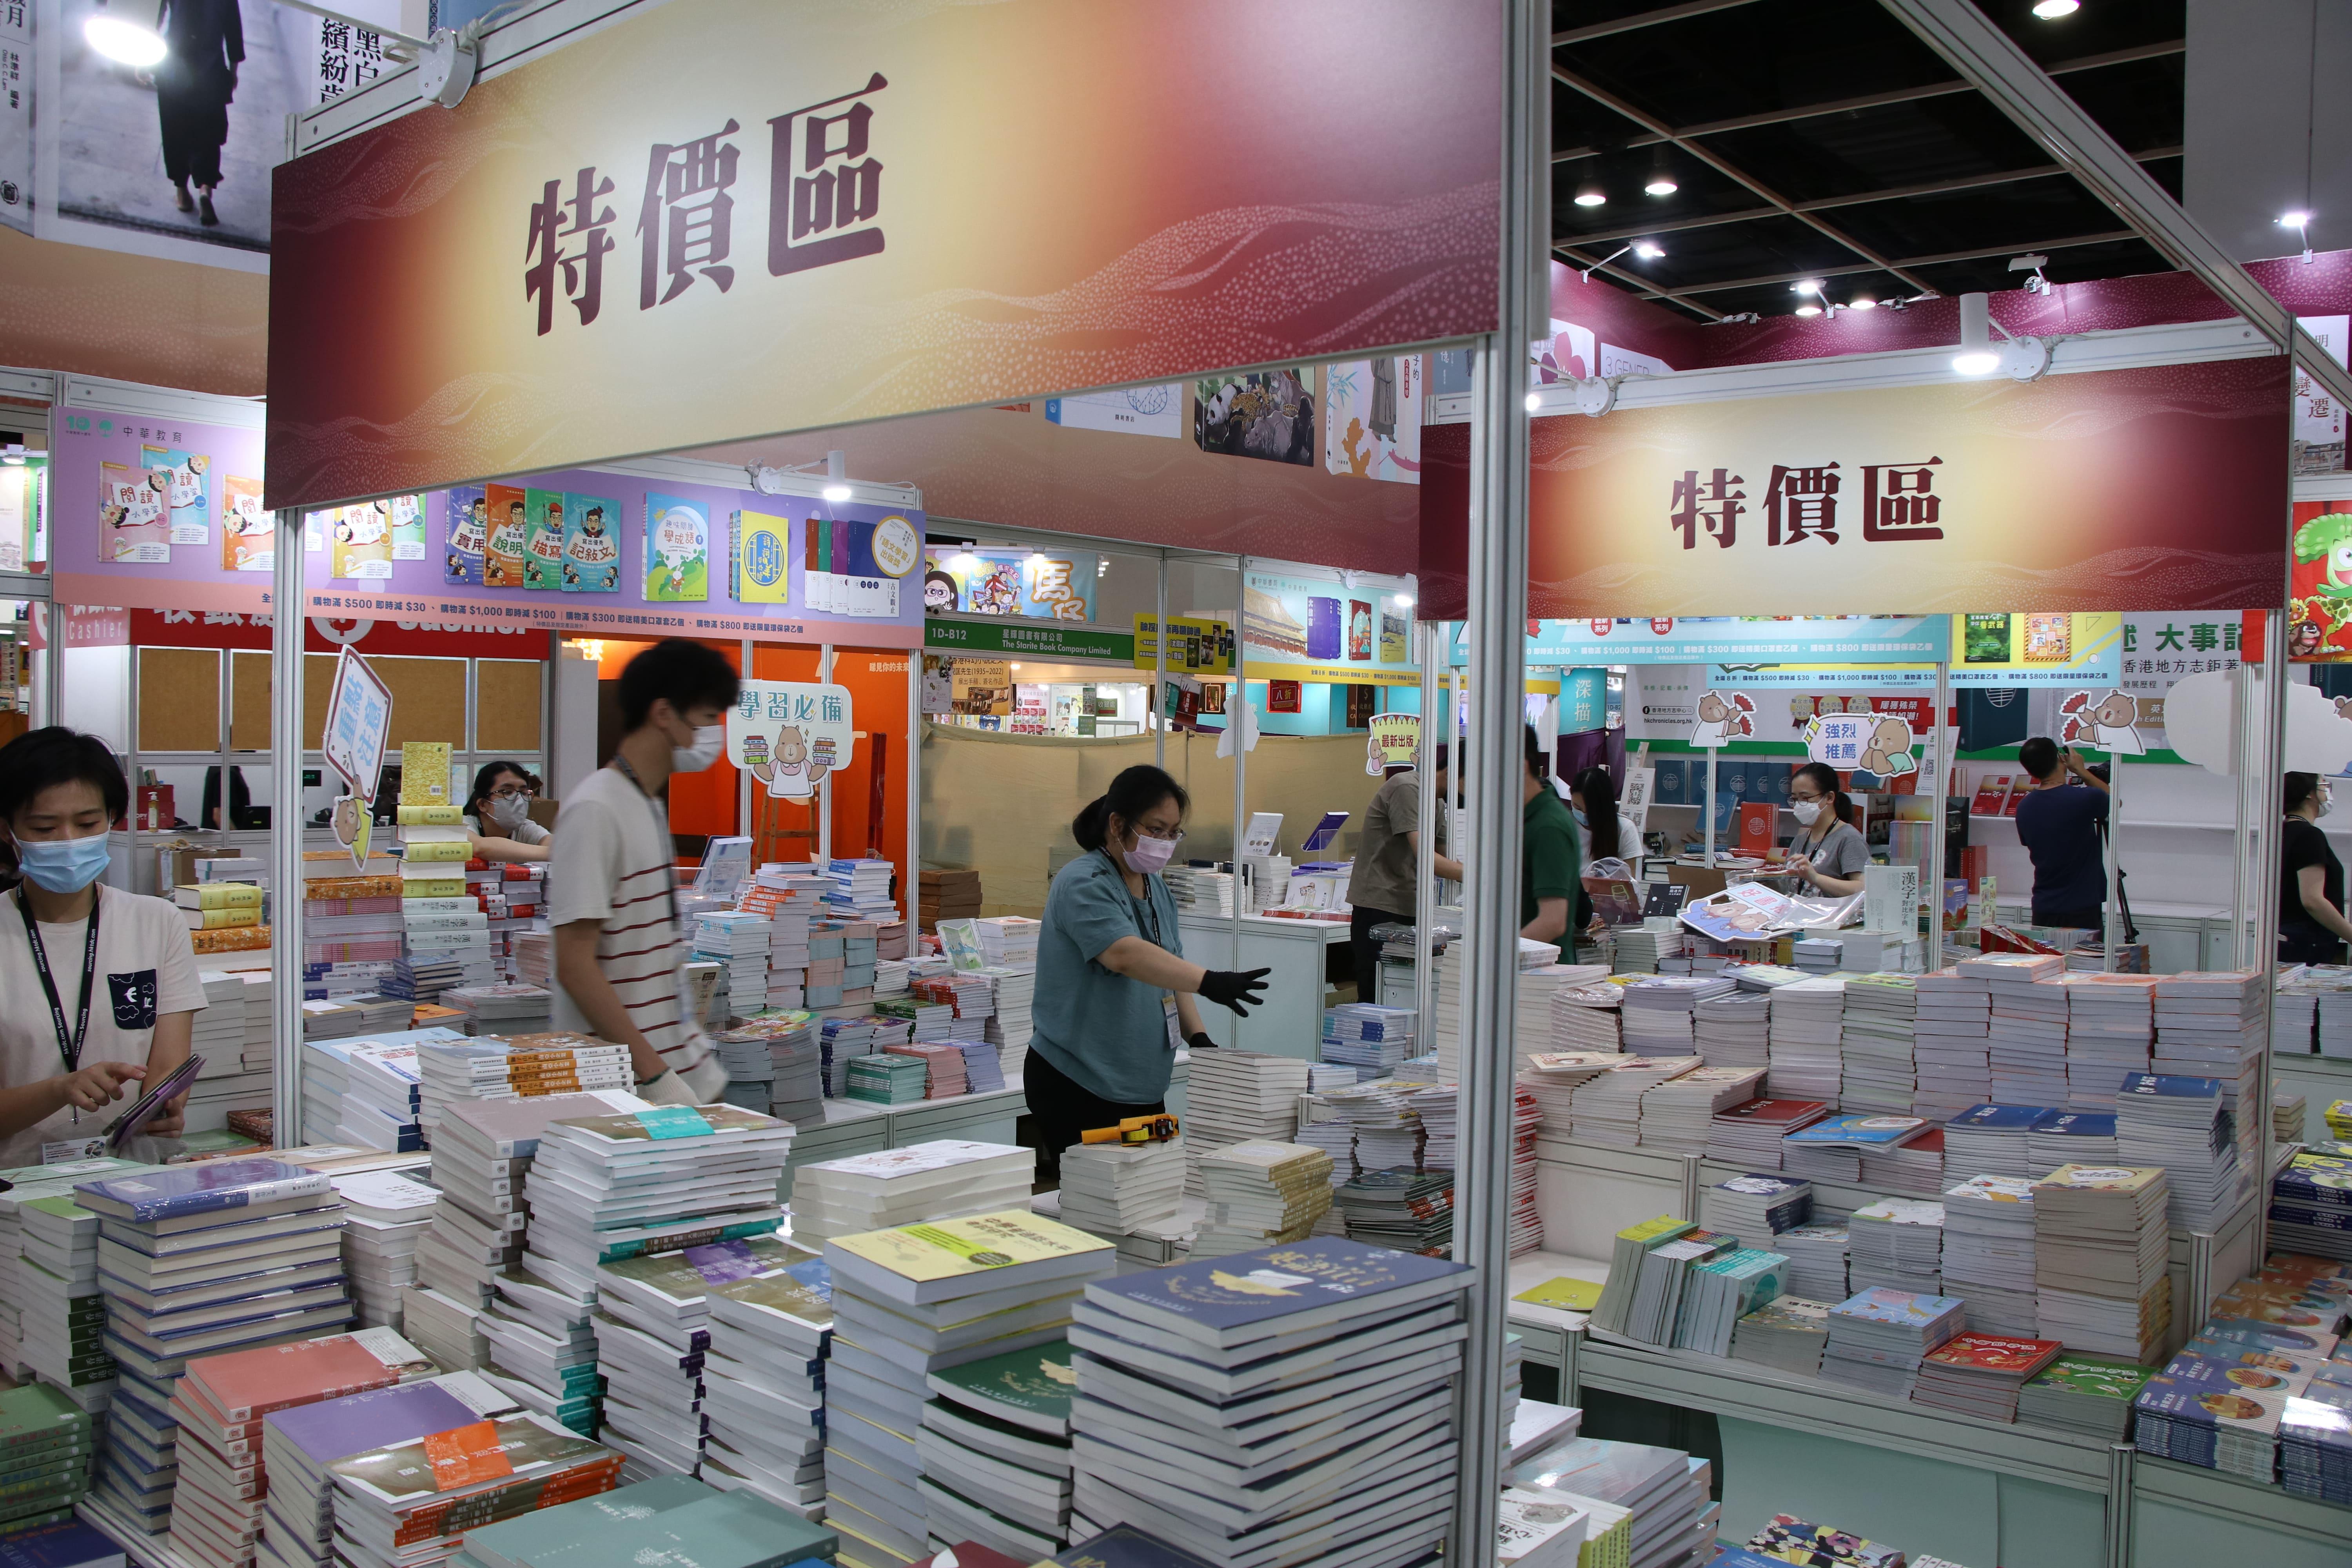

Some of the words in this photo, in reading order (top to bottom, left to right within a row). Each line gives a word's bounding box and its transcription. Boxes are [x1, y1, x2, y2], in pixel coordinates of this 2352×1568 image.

[354, 27, 382, 87] 黑白
[525, 71, 889, 336] 特價區
[2294, 376, 2329, 419] 變遷
[123, 426, 182, 443] 中華教育
[120, 486, 154, 505] 閱讀
[171, 488, 198, 501] 小學堂
[1670, 456, 1944, 550] 特價區
[131, 505, 158, 518] 小學堂
[350, 509, 379, 525] 閱讀
[393, 508, 416, 520] 小學堂
[359, 526, 383, 538] 小學堂
[665, 520, 693, 531] 趣味閱讀
[492, 535, 523, 554] 說明
[664, 530, 694, 544] 學成語
[532, 540, 561, 558] 描寫
[880, 549, 901, 568] 出版獎
[1033, 561, 1086, 621] 馬仔
[313, 596, 341, 607] 購物滿
[345, 599, 372, 609] $500
[376, 600, 403, 611] 即時減
[406, 602, 426, 612] $30
[440, 602, 466, 615] 購物滿
[470, 605, 503, 617] $1,000
[505, 606, 530, 619] 即時減
[533, 610, 556, 620] $100
[566, 611, 590, 622] 購物滿
[592, 613, 615, 623] $300
[617, 614, 684, 628] 即送精美口罩套乙個
[696, 618, 718, 629] 購物滿
[720, 620, 741, 630] $800
[743, 622, 804, 634] 即送限量環保袋乙個
[69, 620, 122, 641] Cashier
[1594, 624, 1608, 633] 系列
[1654, 623, 1669, 633] 系列
[1980, 620, 2004, 630] 看武器
[931, 628, 967, 641] 1D-B12
[1002, 628, 1063, 643] 星輝圖書有限公司
[2154, 623, 2242, 653] 大事記
[1002, 639, 1014, 648] The
[1016, 640, 1038, 650] Starite
[1040, 641, 1056, 651] Book
[1058, 644, 1087, 655] Company
[1088, 646, 1111, 655] Limited
[1603, 646, 1630, 655] $1,000
[1632, 645, 1653, 655] 即時減
[1655, 645, 1675, 655] $100
[1683, 644, 1705, 655] 購物滿
[1707, 644, 1729, 654] $300
[1731, 644, 1798, 654] 即送精美口罩套乙個
[1810, 643, 1834, 652] 購物滿
[1836, 643, 1859, 652] $800
[1861, 642, 1933, 652] 即送限量環保袋乙個
[2123, 680, 2157, 689] 發展歷程
[1275, 689, 1293, 702] 八折
[338, 674, 364, 751] 重點
[738, 690, 843, 723] 學習必備
[1574, 679, 1592, 732] 深描
[359, 694, 382, 768] 注意
[1825, 723, 1857, 739] 強烈
[1381, 734, 1414, 748] 最新出版
[1825, 743, 1857, 759] 推薦
[1901, 872, 1916, 899] 漢字
[440, 901, 458, 911] 漢字
[1908, 900, 1915, 913] 字形
[450, 918, 468, 927] 漢字
[453, 934, 470, 943] 漢字
[29, 928, 47, 973] sourcing.hktdc.com
[87, 927, 96, 973] sourcing.hktdc.com
[54, 1007, 62, 1027] Sourcing
[79, 1008, 88, 1031] Sourcing
[60, 1027, 70, 1054] hktdc.com
